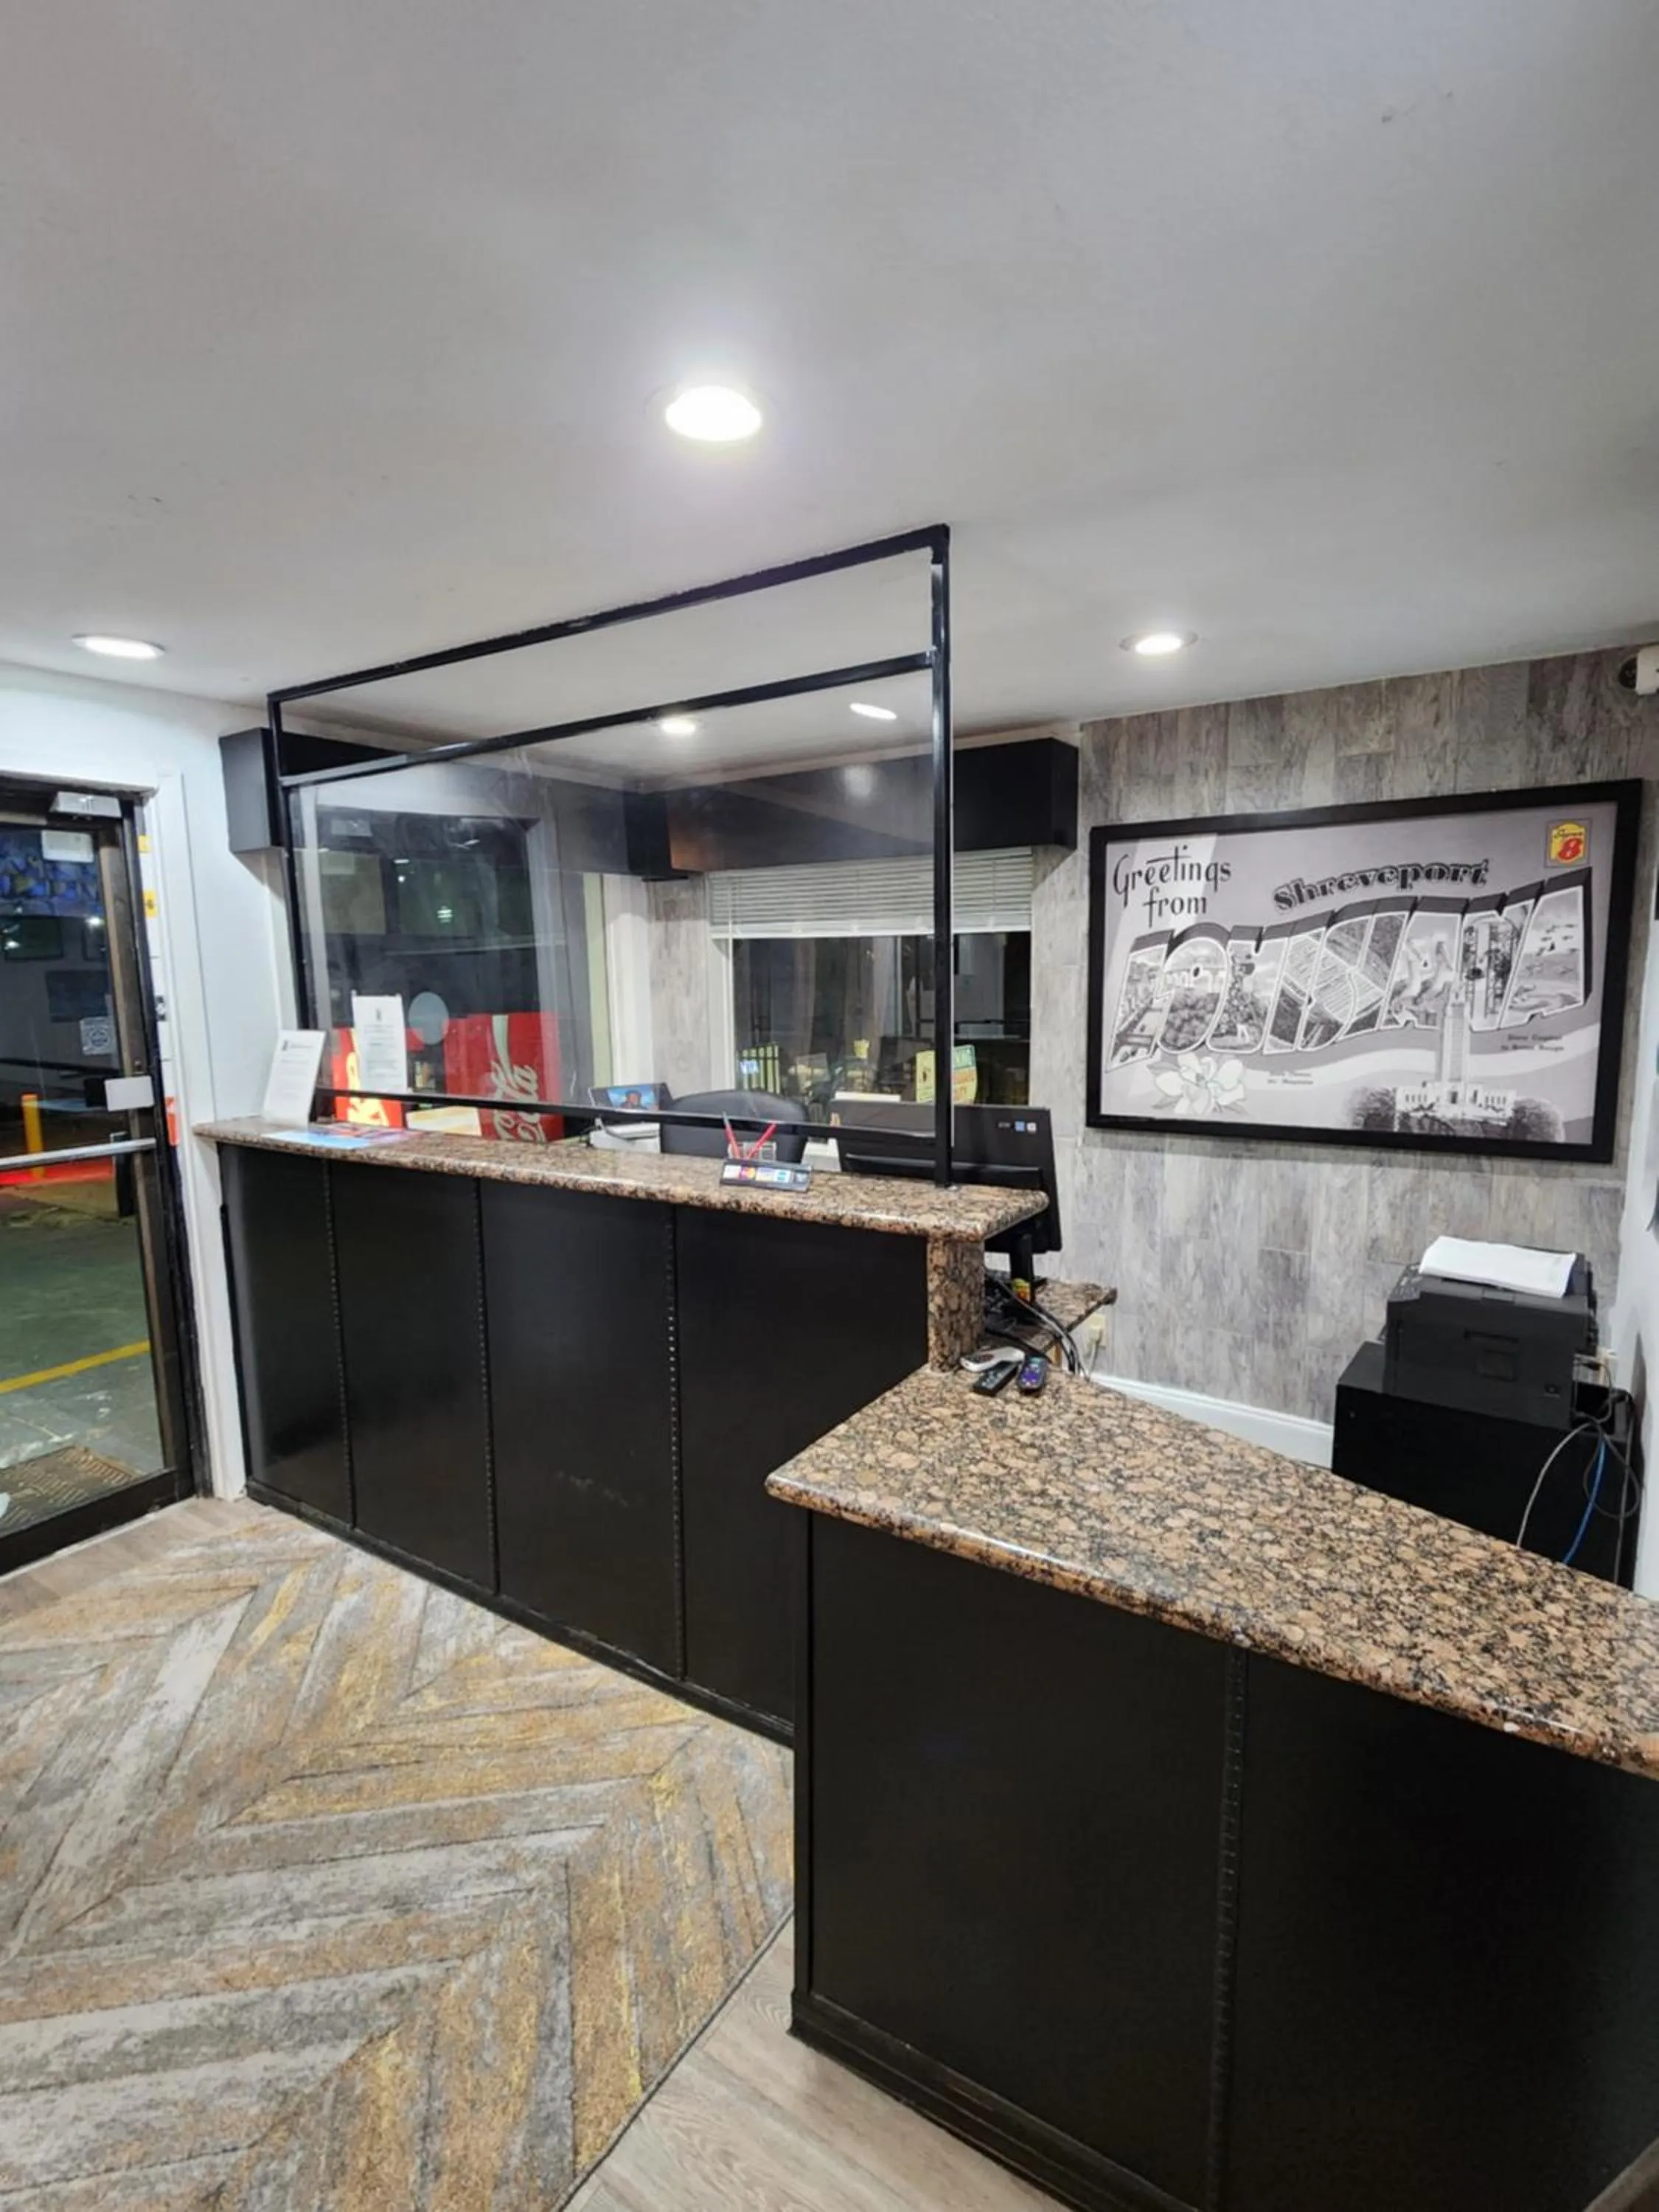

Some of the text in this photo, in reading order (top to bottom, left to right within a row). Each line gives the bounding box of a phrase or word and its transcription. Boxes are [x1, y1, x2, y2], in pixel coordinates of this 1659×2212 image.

[1557, 837, 1583, 860] 8
[1113, 845, 1231, 908] Greetings
[1273, 858, 1489, 913] Shreveport
[1143, 886, 1207, 928] from
